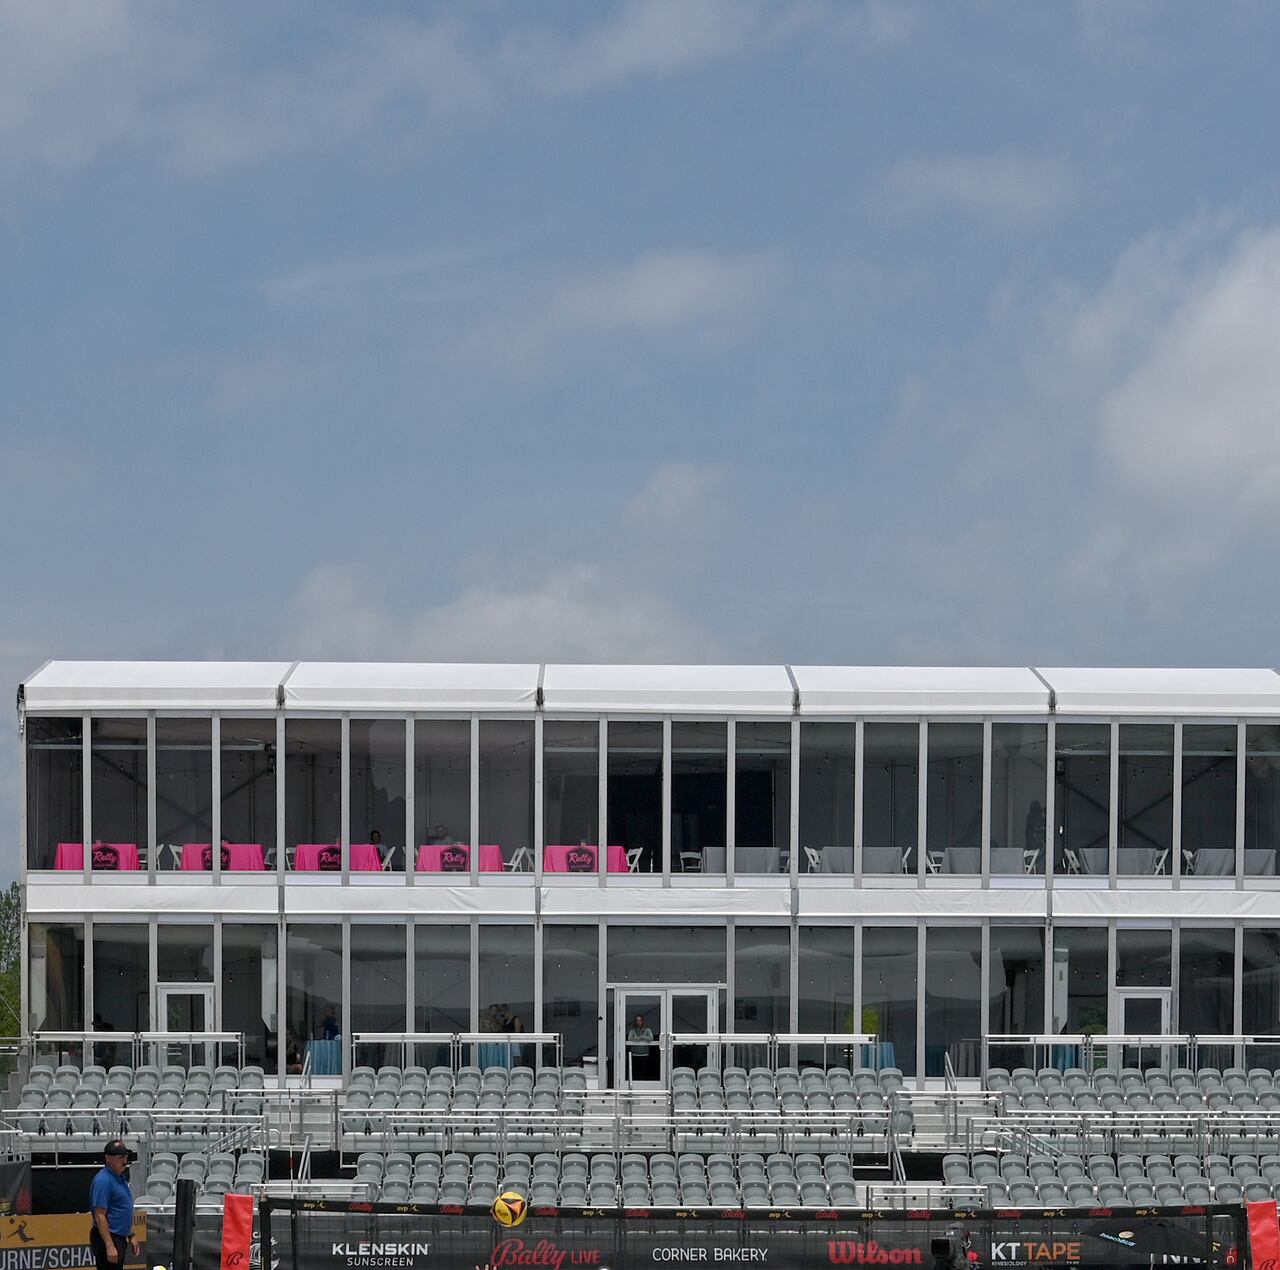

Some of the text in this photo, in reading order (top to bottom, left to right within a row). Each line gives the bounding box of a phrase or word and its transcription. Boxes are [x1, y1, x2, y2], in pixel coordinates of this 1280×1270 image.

[571, 1249, 601, 1264] LIVE
[652, 1248, 708, 1262] CORNER
[827, 1240, 924, 1264] Wilson
[991, 1242, 1082, 1260] KT TAPE
[346, 1257, 414, 1267] SUNSCREEN
